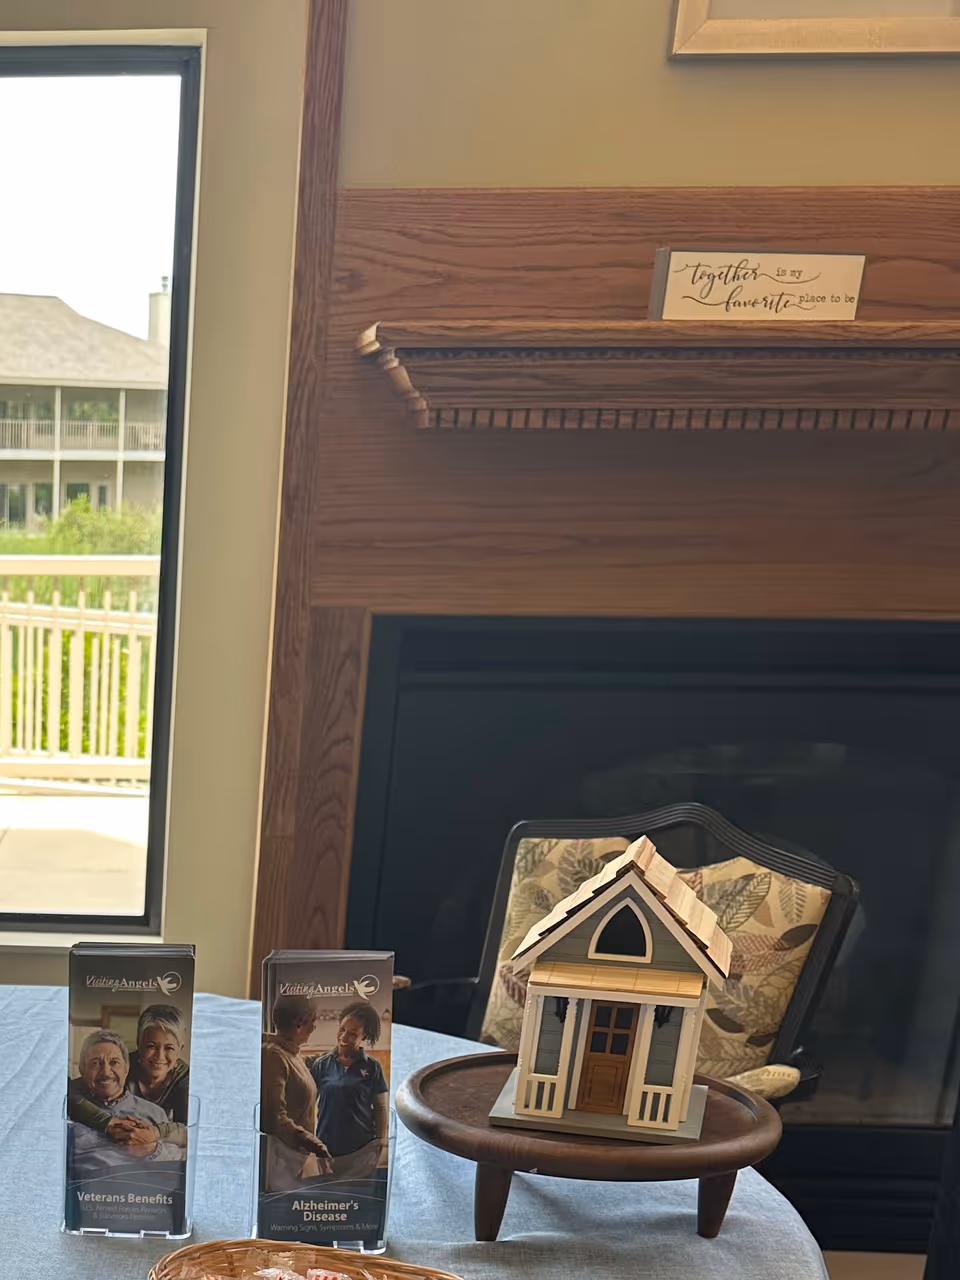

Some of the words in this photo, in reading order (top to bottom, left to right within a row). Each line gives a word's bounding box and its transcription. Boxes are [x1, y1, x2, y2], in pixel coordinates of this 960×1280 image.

[673, 259, 762, 299] together
[776, 267, 788, 277] is
[790, 268, 803, 280] my
[708, 285, 797, 313] favorite
[799, 294, 827, 305] place
[830, 294, 842, 303] to
[844, 294, 855, 304] be
[77, 1191, 125, 1203] Veterans
[127, 1193, 173, 1204] Benefits
[292, 1199, 359, 1210] Alzheimer's
[303, 1212, 347, 1221] Disease
[270, 1224, 298, 1232] Warning
[319, 1223, 354, 1232] Symptoms
